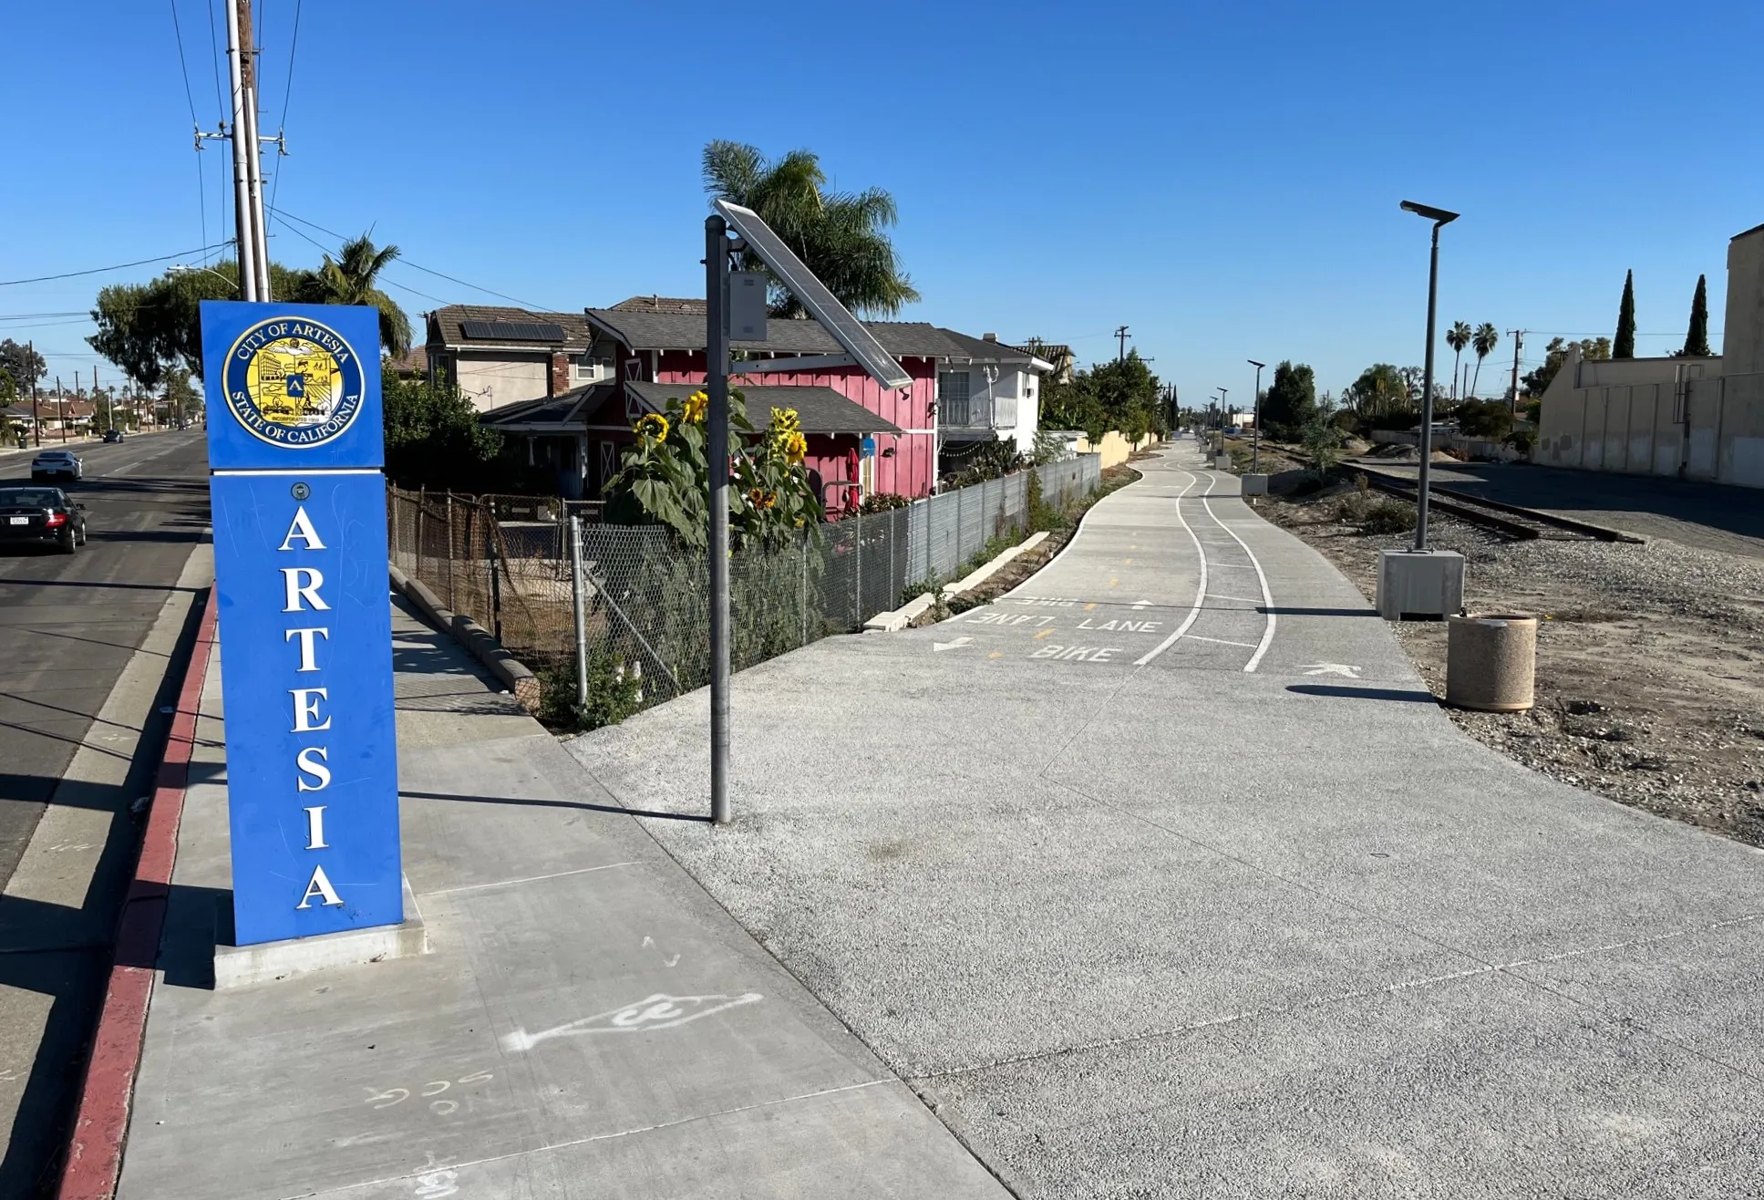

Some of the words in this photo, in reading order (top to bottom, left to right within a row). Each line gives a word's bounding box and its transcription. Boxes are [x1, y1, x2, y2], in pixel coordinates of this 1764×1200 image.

[237, 330, 267, 360] CITY
[268, 323, 288, 337] OF
[292, 323, 349, 363] ARTESIA
[232, 391, 266, 430] STATE
[265, 425, 286, 440] OF
[287, 395, 358, 442] CALIFORNIA
[966, 613, 1055, 627] LANE
[1076, 618, 1163, 633] LANE
[1027, 645, 1124, 662] BIKE
[277, 505, 344, 910] ARTESIA
